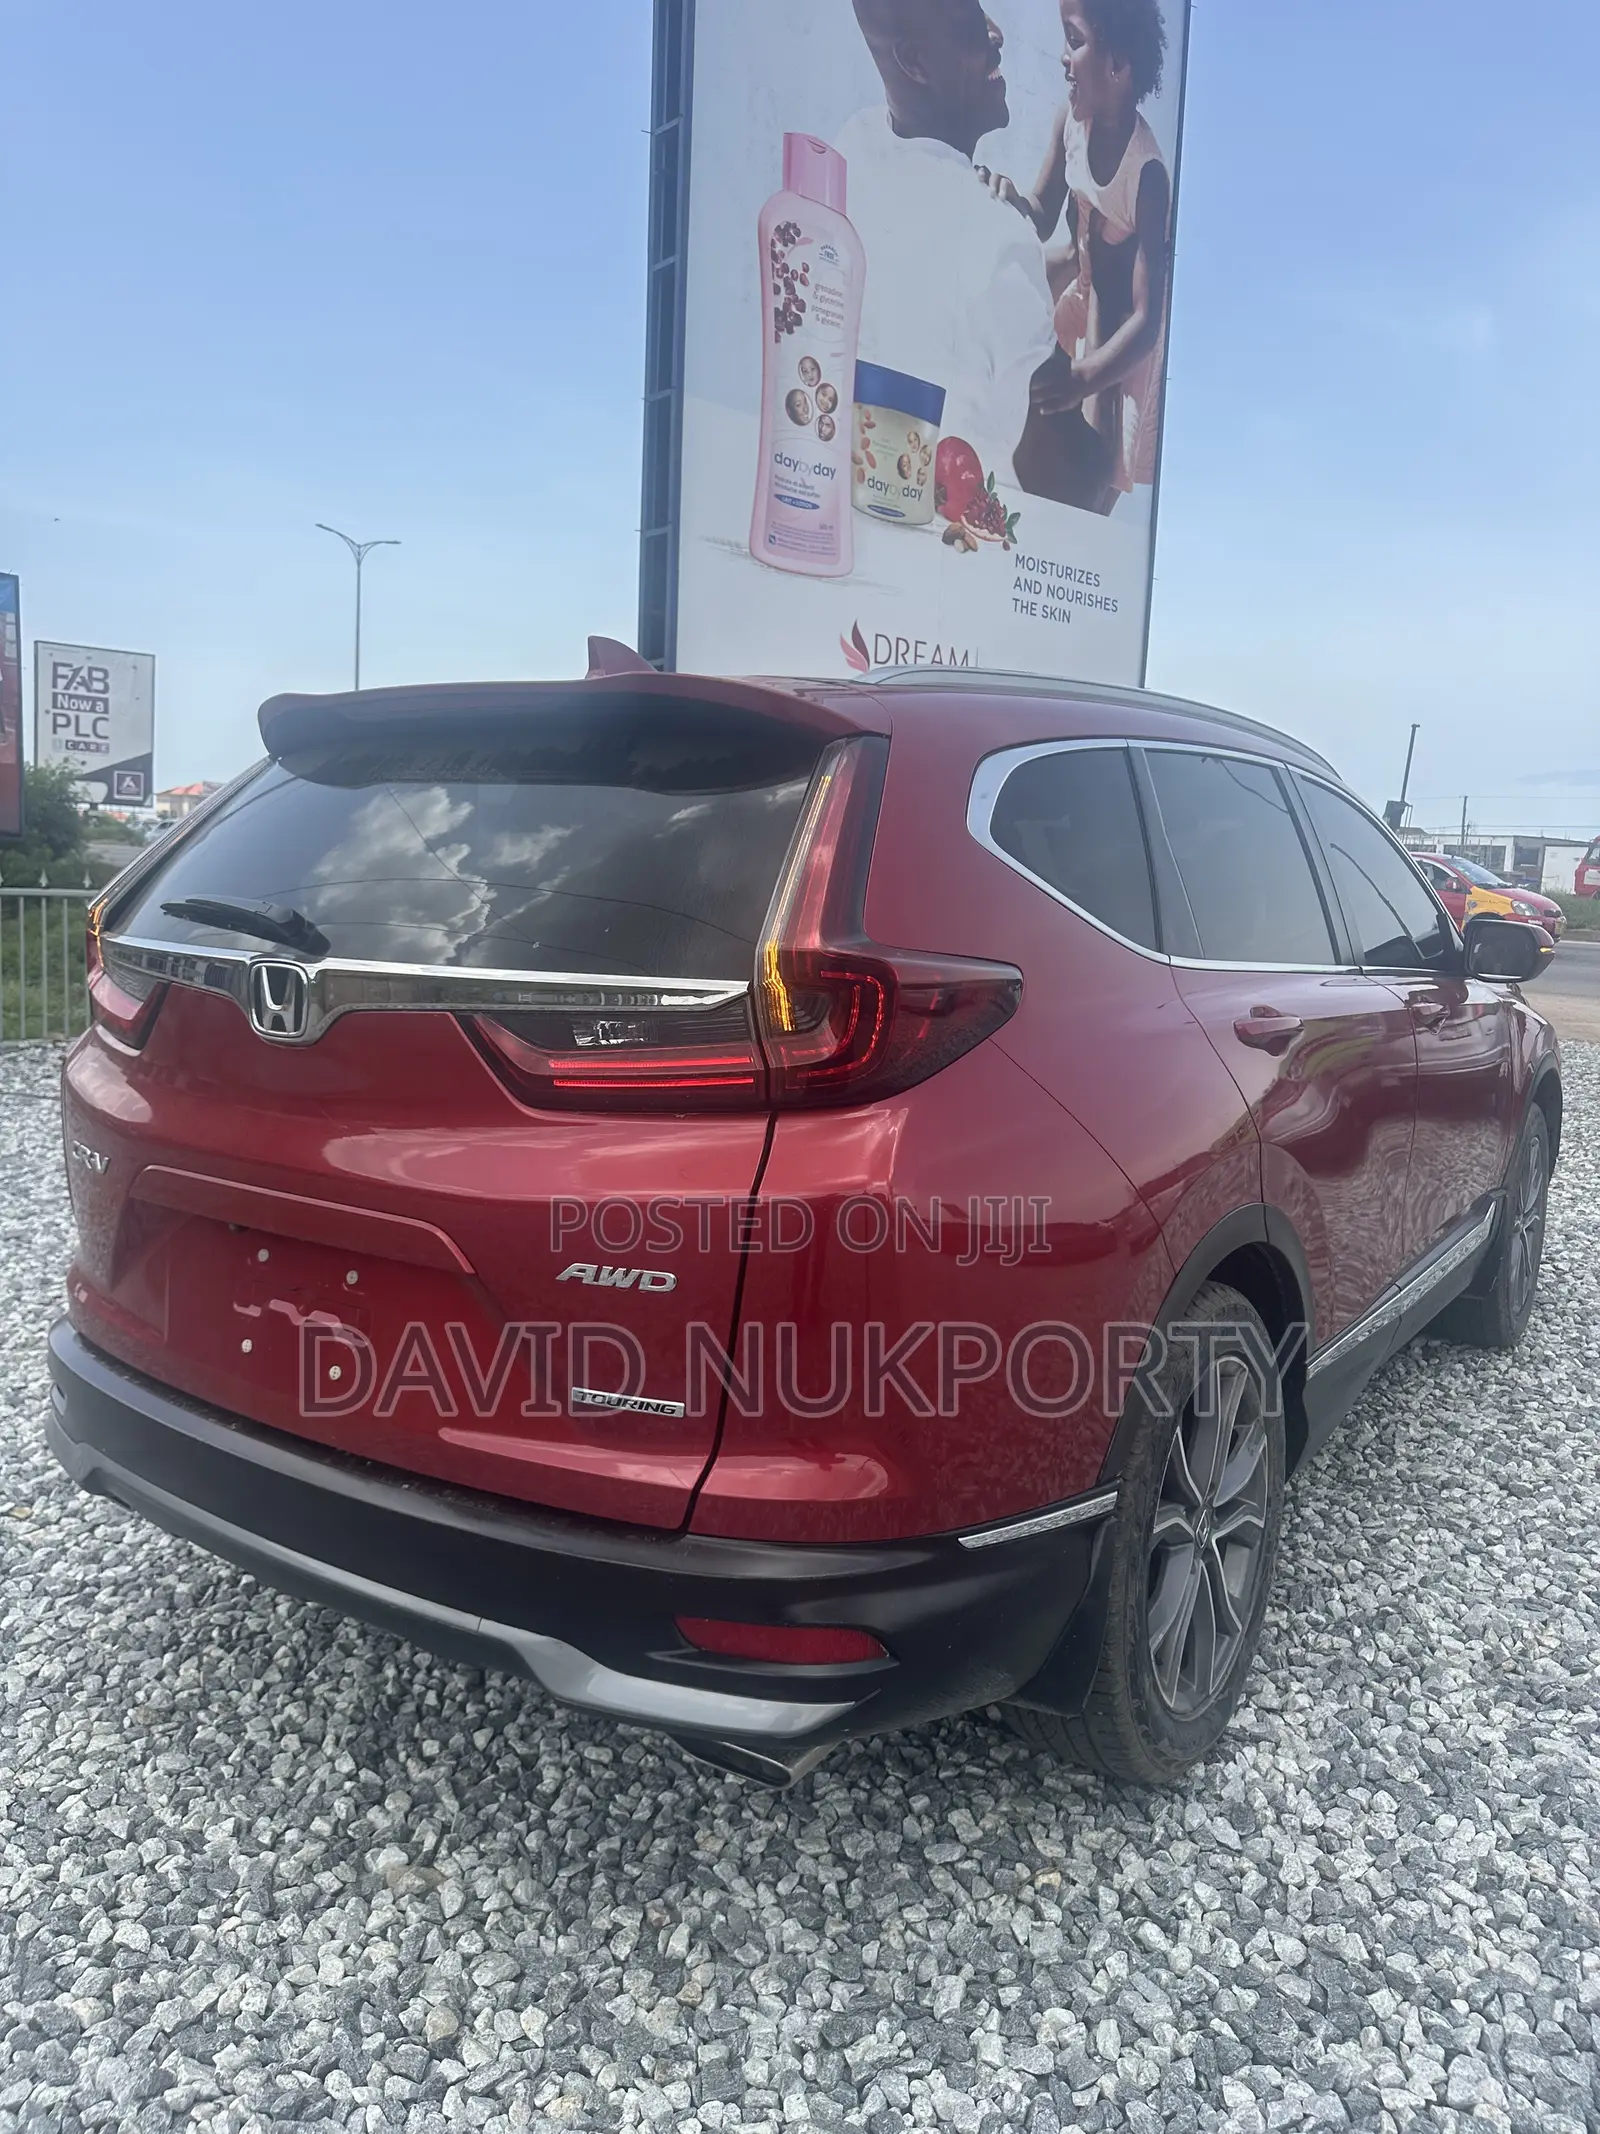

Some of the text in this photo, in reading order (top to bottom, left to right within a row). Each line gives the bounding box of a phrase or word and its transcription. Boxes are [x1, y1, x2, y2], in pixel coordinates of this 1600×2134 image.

[1015, 553, 1100, 587] MOISTURIZES
[1013, 576, 1118, 613] AND NOURISHES
[1012, 598, 1071, 624] THE SKIN
[57, 694, 104, 712] Now a
[52, 712, 110, 739] PLC
[556, 1262, 677, 1292] AWD
[576, 1390, 677, 1415] TOURING
